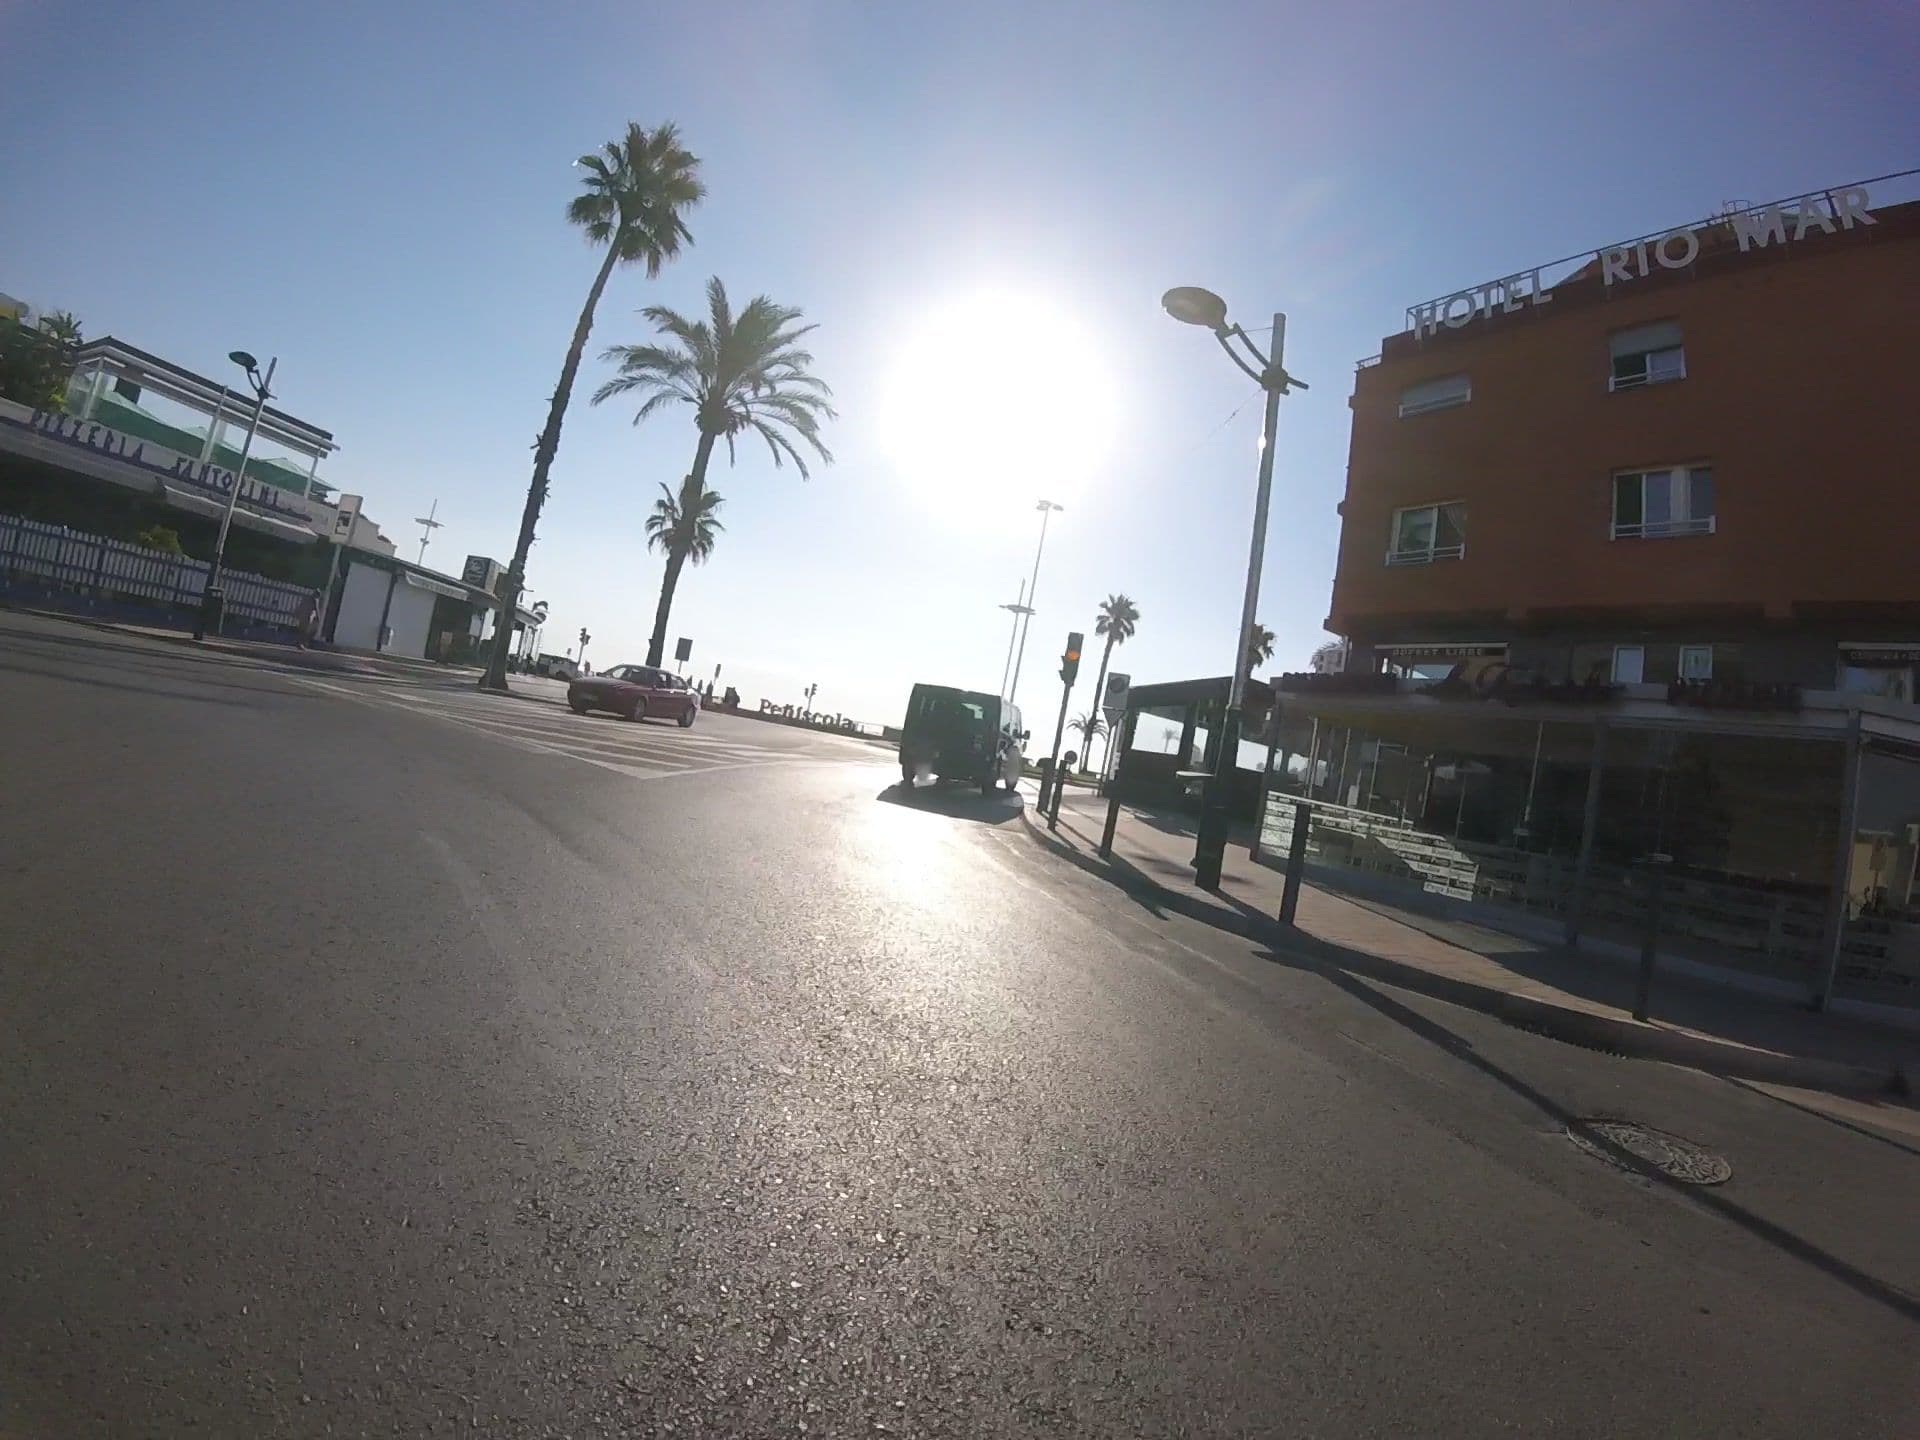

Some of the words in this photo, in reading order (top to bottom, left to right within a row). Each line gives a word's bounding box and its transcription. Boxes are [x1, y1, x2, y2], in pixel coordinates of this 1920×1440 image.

[1413, 270, 1553, 341] HOTEL
[1602, 227, 1699, 286] RIO
[1732, 187, 1878, 251] MAR
[31, 408, 144, 460] PIZZERIA
